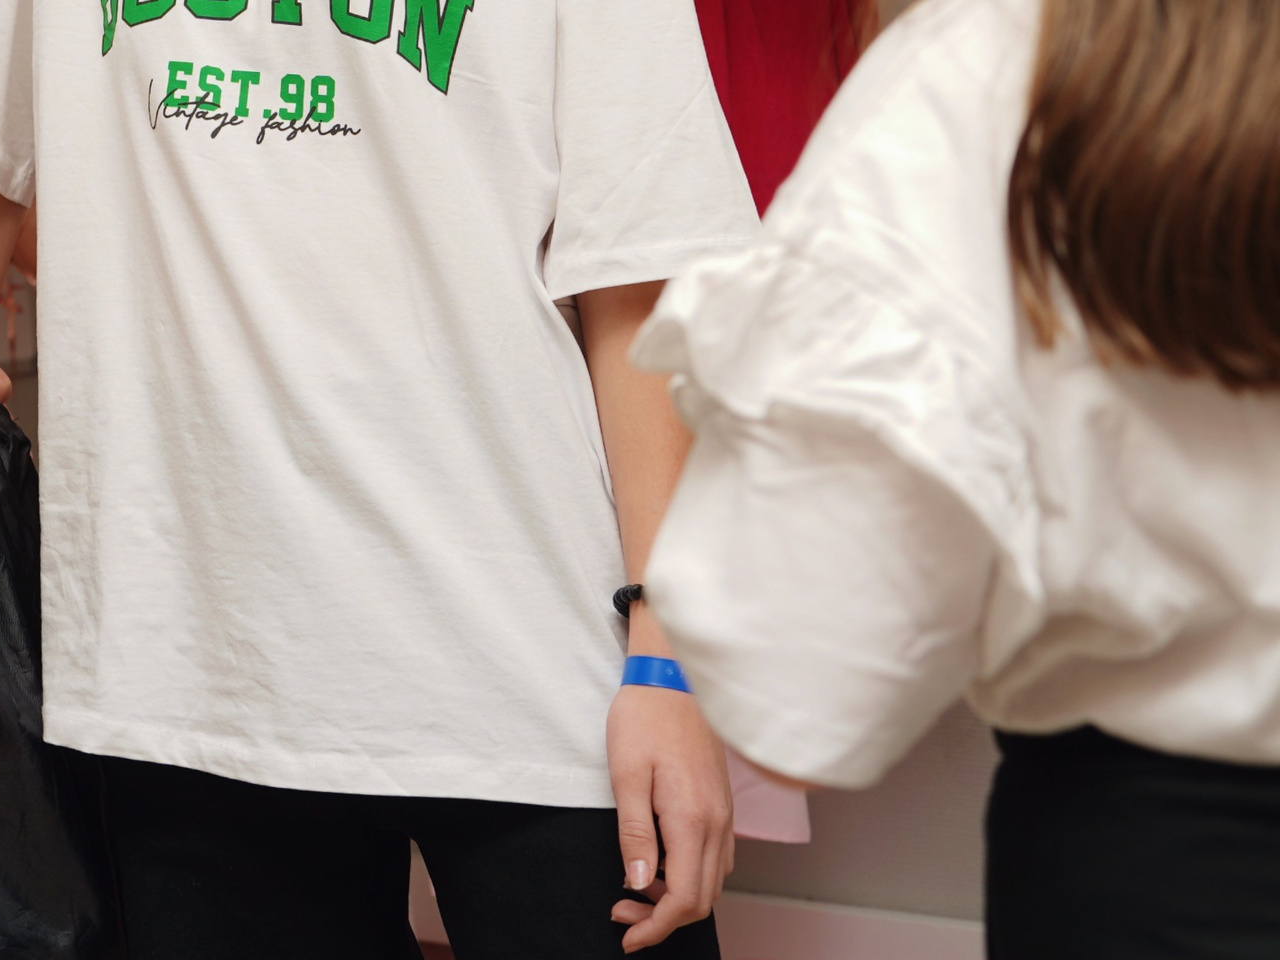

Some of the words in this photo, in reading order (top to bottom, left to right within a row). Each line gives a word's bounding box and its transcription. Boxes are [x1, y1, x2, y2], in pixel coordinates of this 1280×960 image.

[148, 78, 244, 139] Vintage
[256, 106, 361, 145] fashion
[163, 60, 336, 123] EST.98
